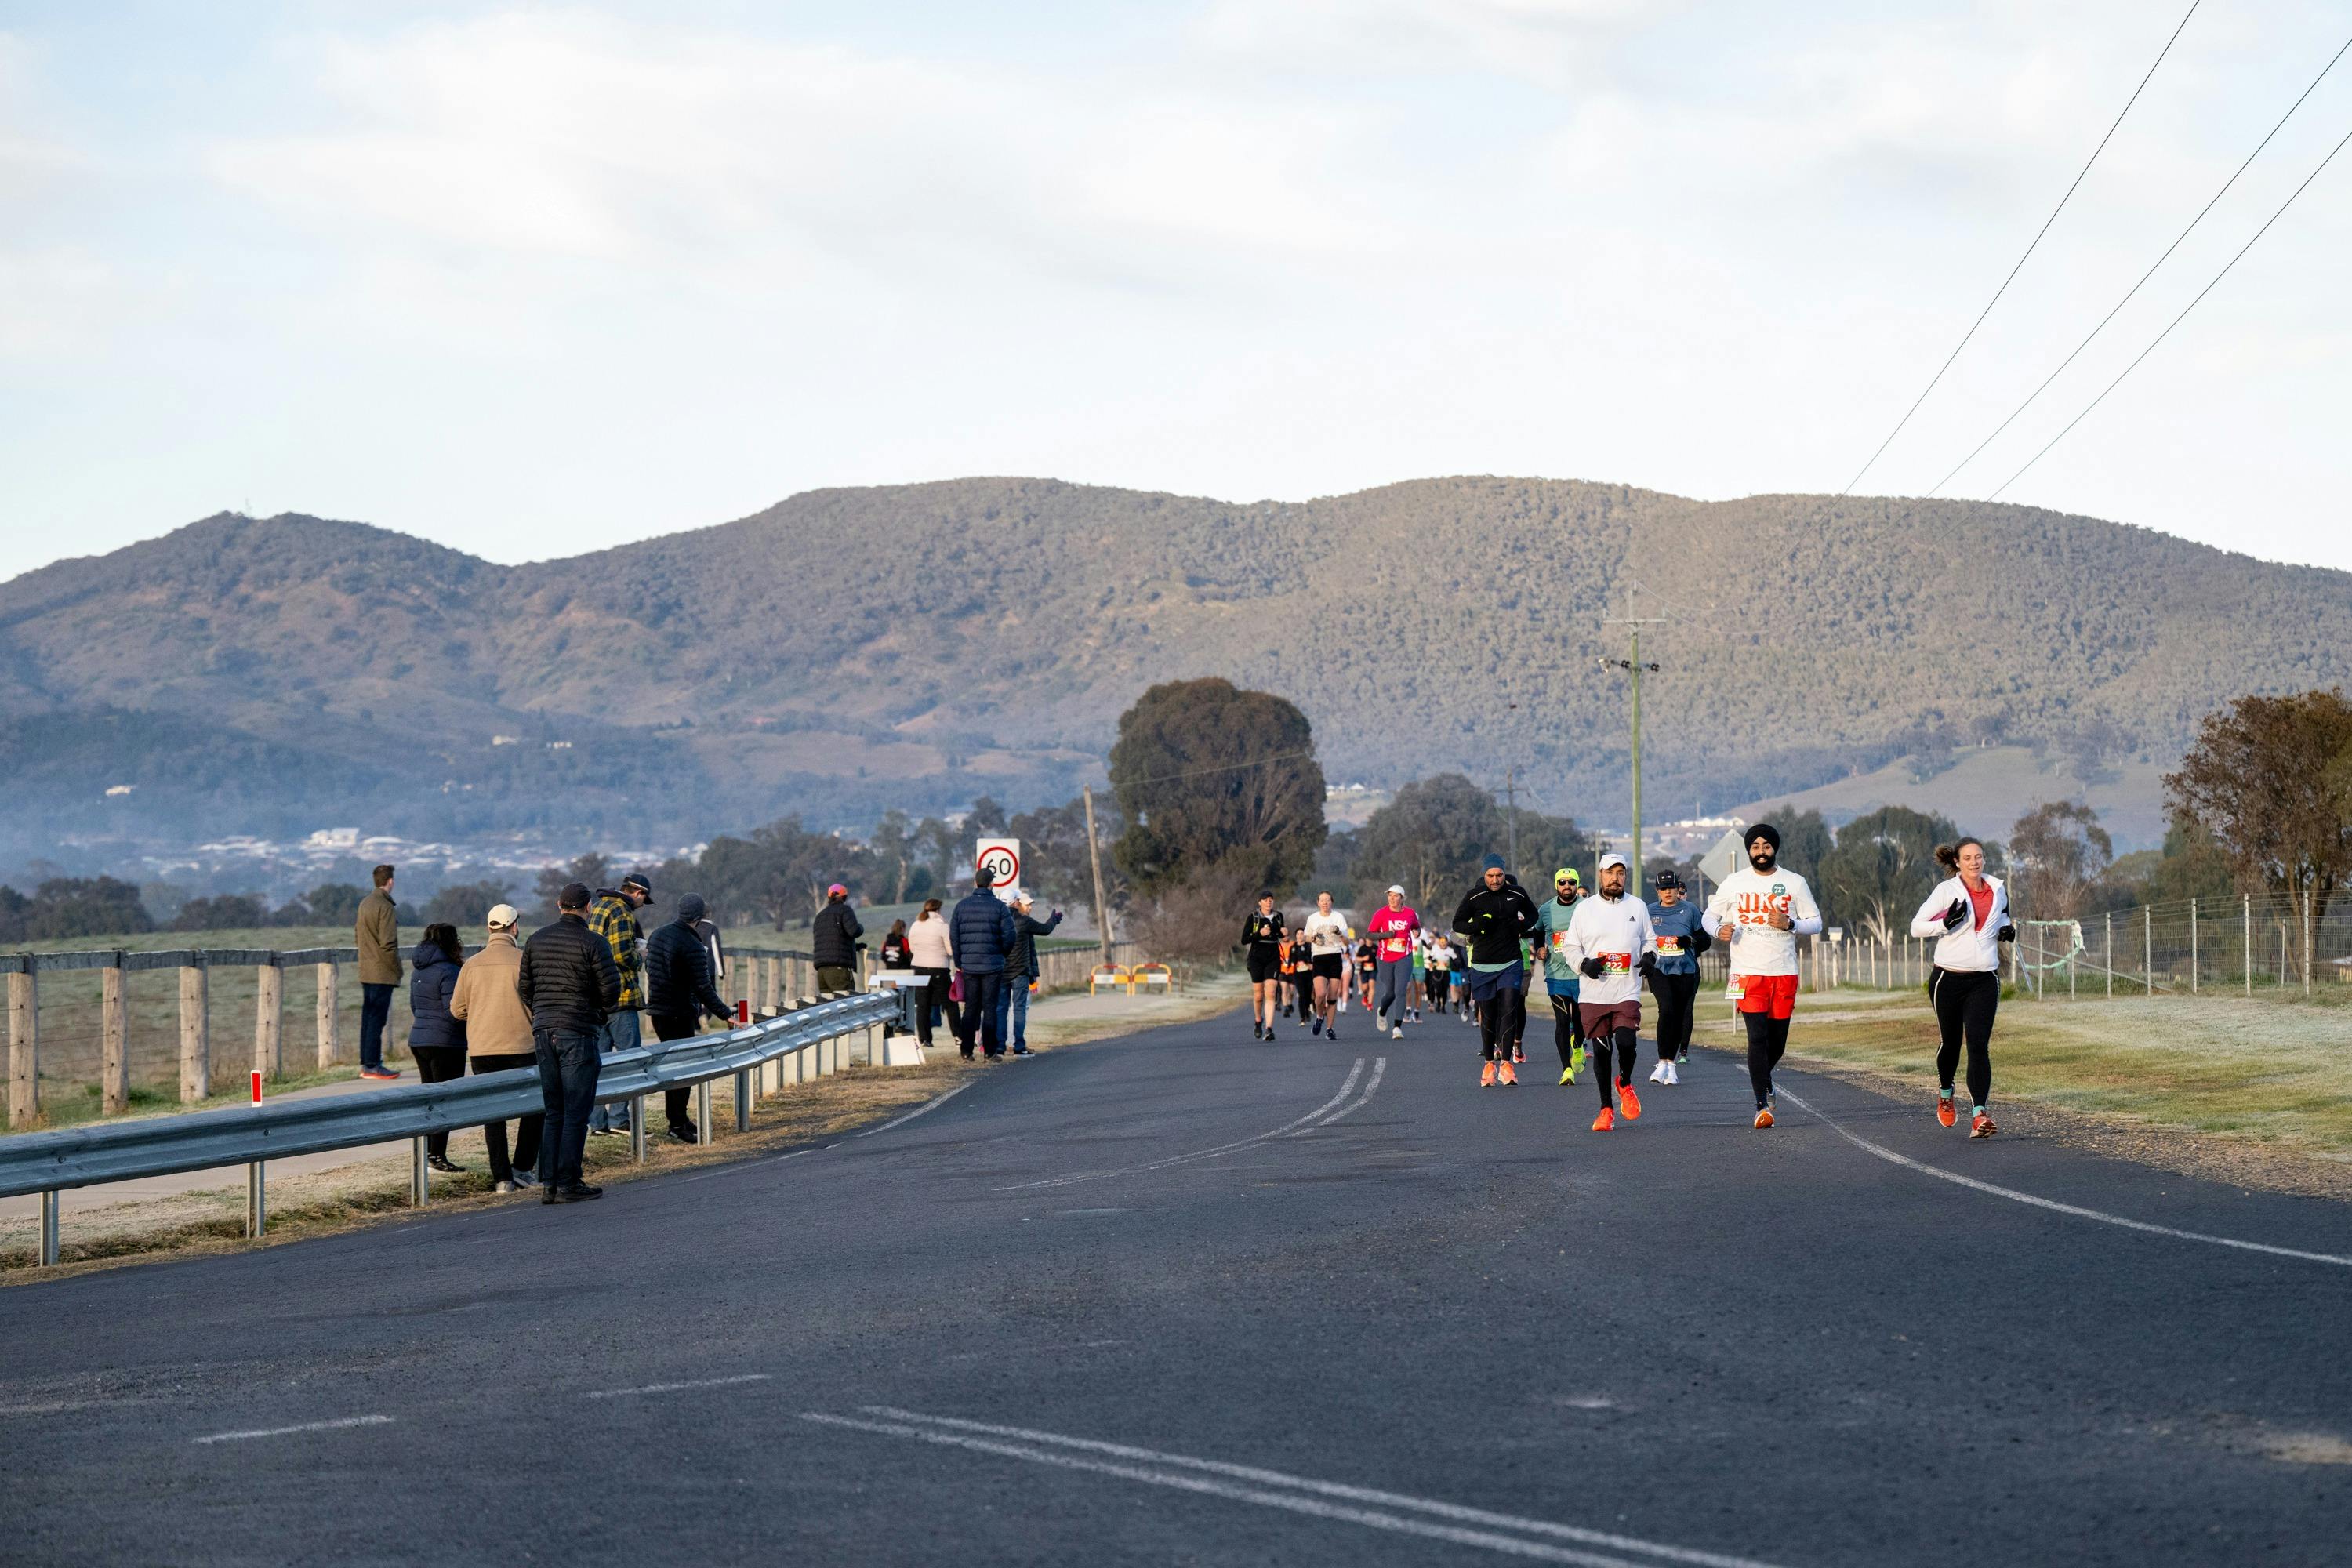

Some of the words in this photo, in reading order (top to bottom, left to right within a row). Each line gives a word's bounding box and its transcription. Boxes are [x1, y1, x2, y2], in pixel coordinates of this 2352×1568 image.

[986, 858, 1011, 875] 60
[1736, 893, 1791, 914] NIKE
[1606, 961, 1623, 971] 222
